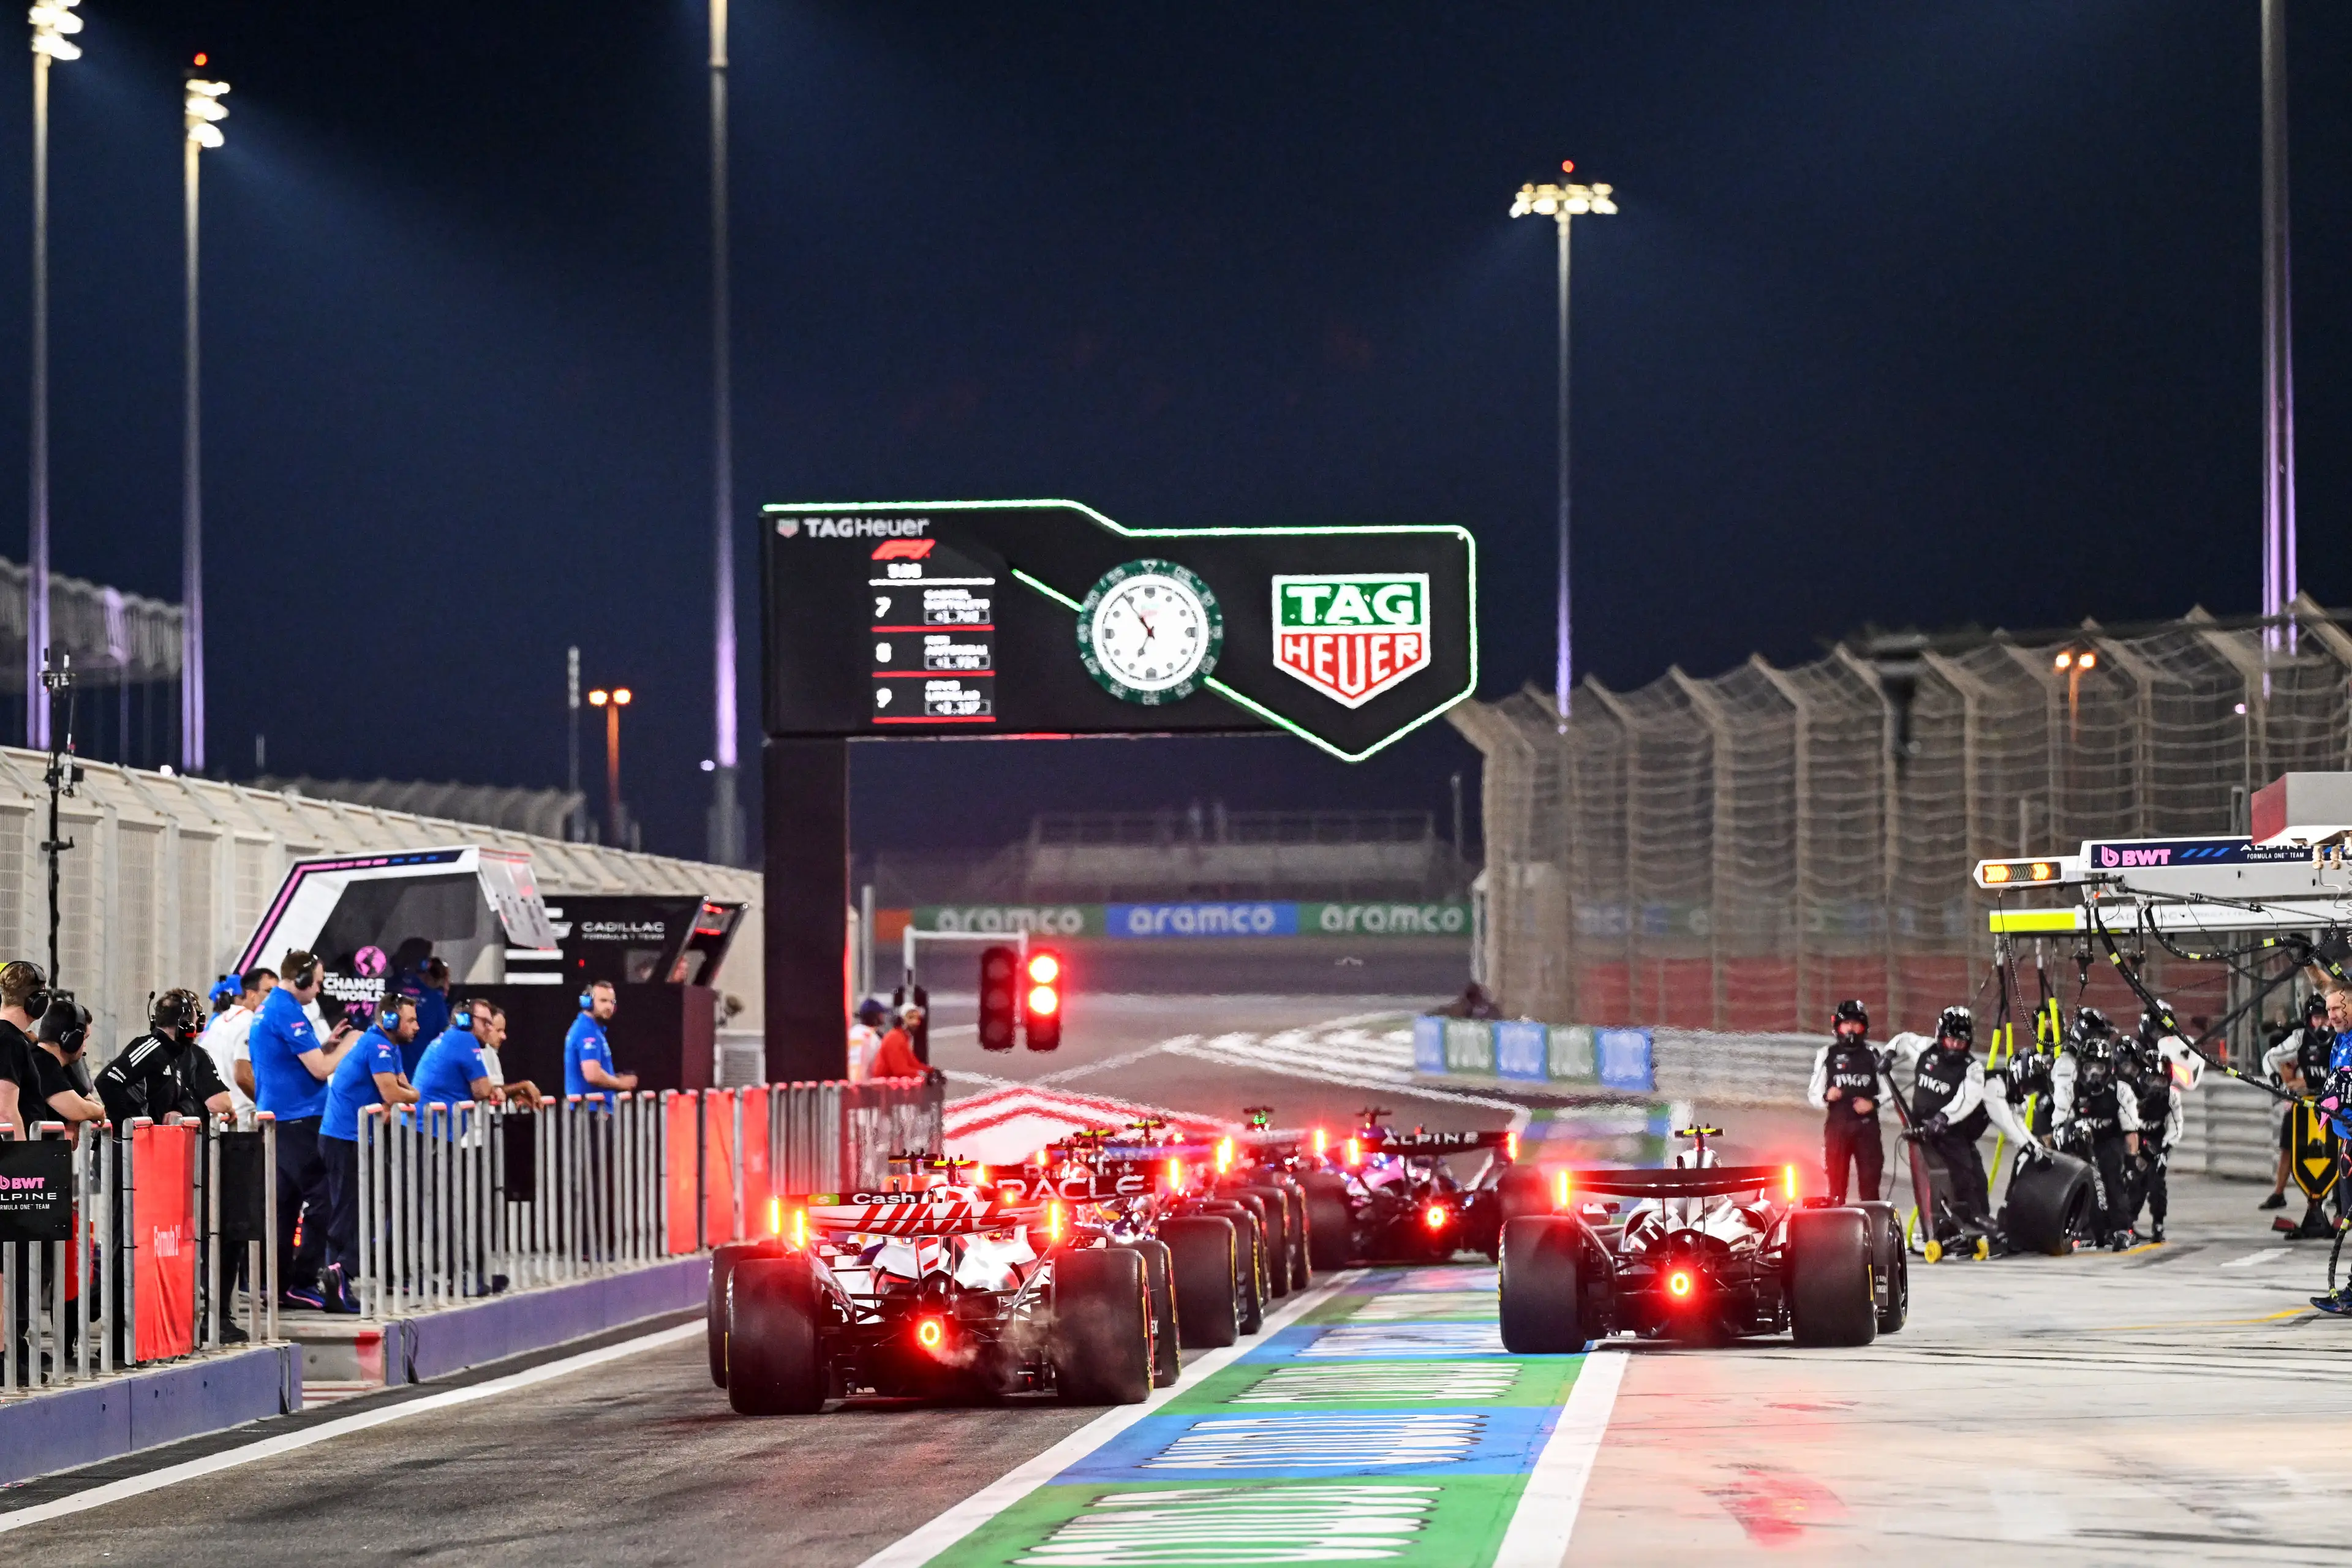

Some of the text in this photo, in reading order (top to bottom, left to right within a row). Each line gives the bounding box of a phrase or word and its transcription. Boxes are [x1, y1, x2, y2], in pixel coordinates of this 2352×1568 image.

[875, 597, 891, 618] 7
[1286, 584, 1414, 625] TAG
[1284, 635, 1418, 695] HEUER
[2122, 849, 2171, 866] BWT
[581, 921, 665, 932] CADILLAC
[936, 907, 1085, 936] aramco
[1128, 905, 1276, 935] aramco
[1321, 903, 1465, 933] aramco
[323, 978, 385, 991] CHANGE
[1381, 1126, 1480, 1146] ALPINE
[12, 1177, 45, 1189] BWT
[852, 1193, 916, 1204] Cash
